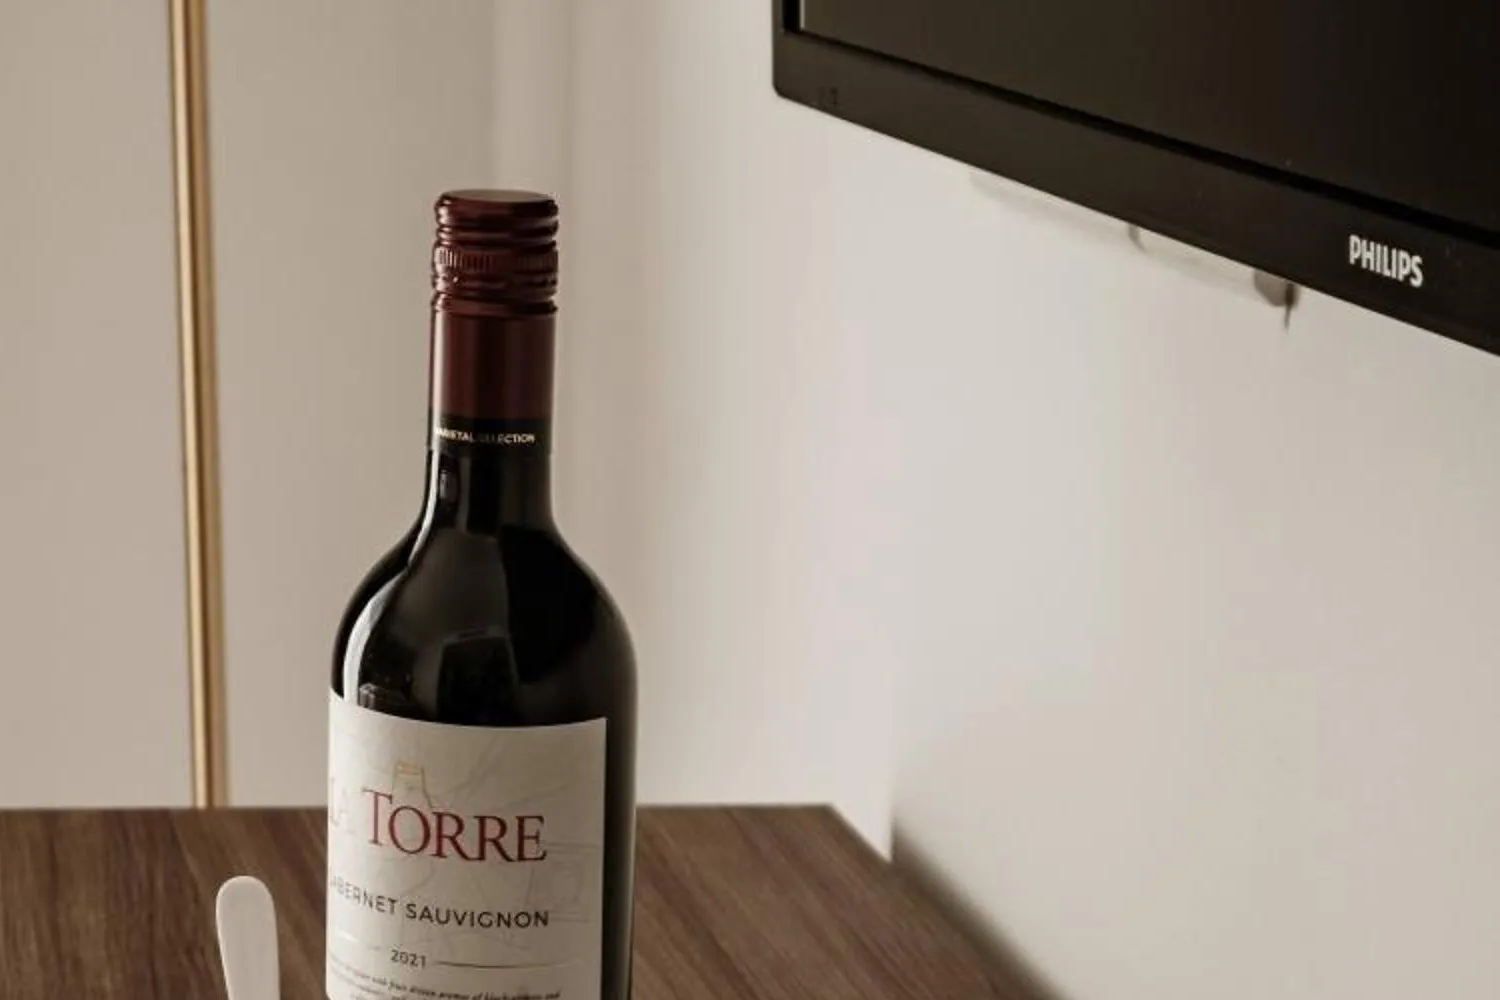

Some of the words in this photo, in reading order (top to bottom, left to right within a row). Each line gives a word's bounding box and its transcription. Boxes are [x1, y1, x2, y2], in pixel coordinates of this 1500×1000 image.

[1349, 234, 1423, 287] PHILIPS
[362, 787, 548, 863] TORRE
[329, 875, 397, 915] ABERNET
[405, 903, 549, 929] SAUVIGNON
[391, 949, 427, 969] 2021
